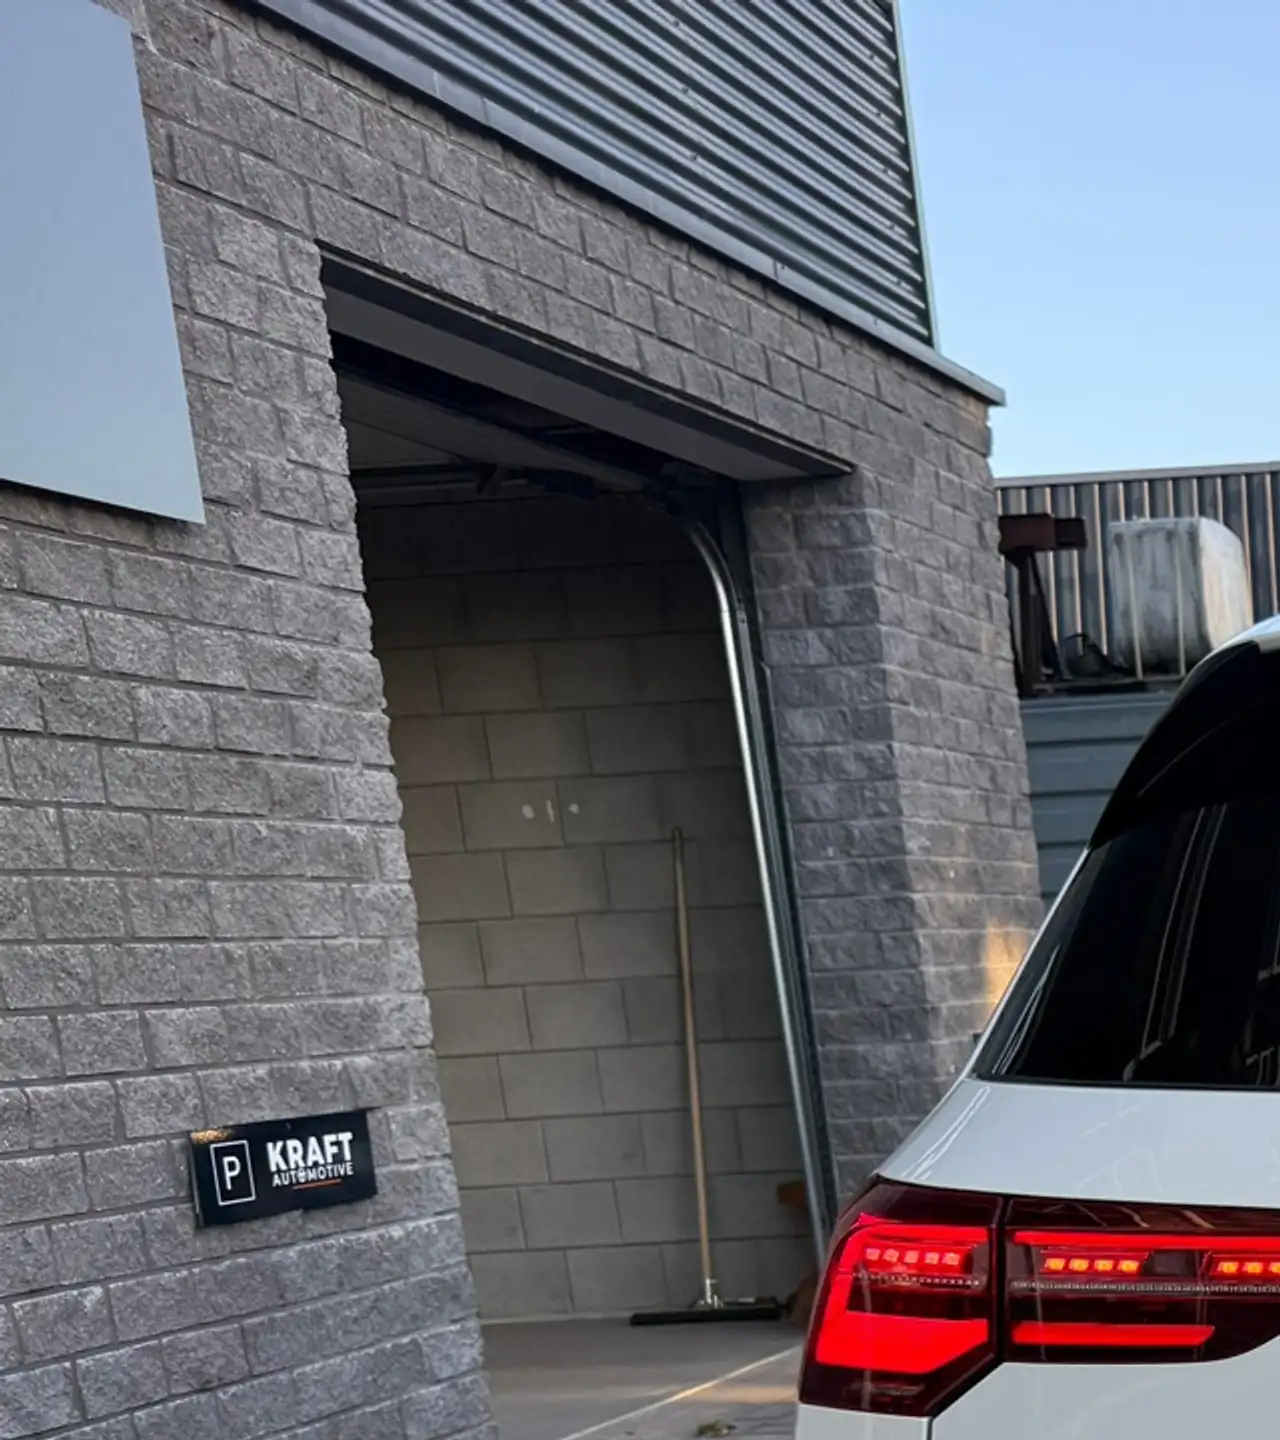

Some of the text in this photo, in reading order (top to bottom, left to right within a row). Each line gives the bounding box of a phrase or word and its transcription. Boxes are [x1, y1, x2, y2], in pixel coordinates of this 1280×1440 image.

[266, 1131, 354, 1173] KRAFT
[222, 1155, 242, 1191] P
[271, 1162, 355, 1188] AUTOMOTIVE
